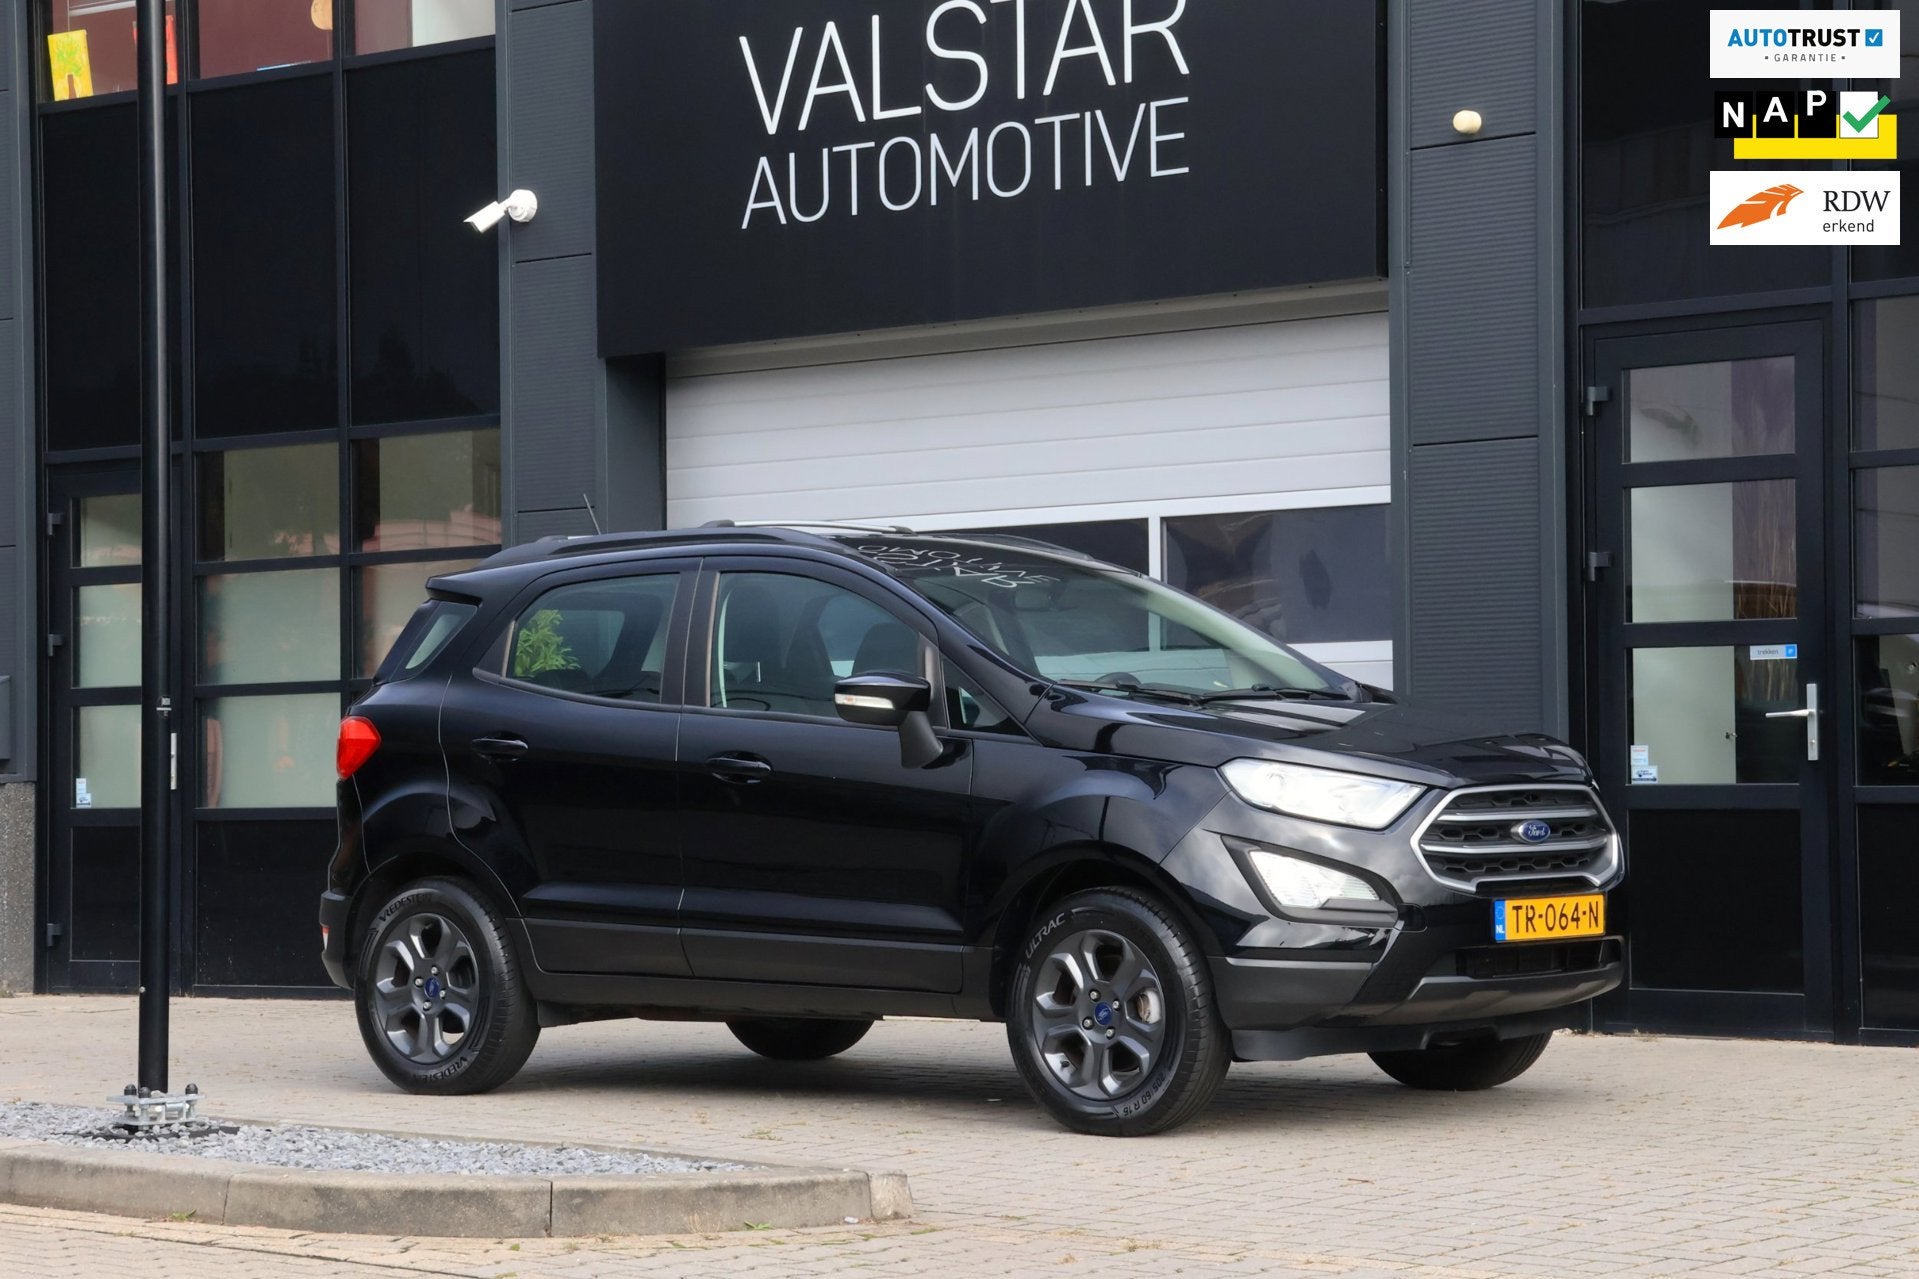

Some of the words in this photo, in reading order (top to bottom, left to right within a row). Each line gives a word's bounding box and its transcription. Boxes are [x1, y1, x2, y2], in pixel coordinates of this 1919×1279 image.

[739, 0, 1190, 135] VALSTAR
[741, 96, 1190, 230] AUTOMOTIVE
[1025, 912, 1066, 959] ULTRAC
[1495, 925, 1505, 934] NL
[1512, 900, 1599, 934] TR-064-N
